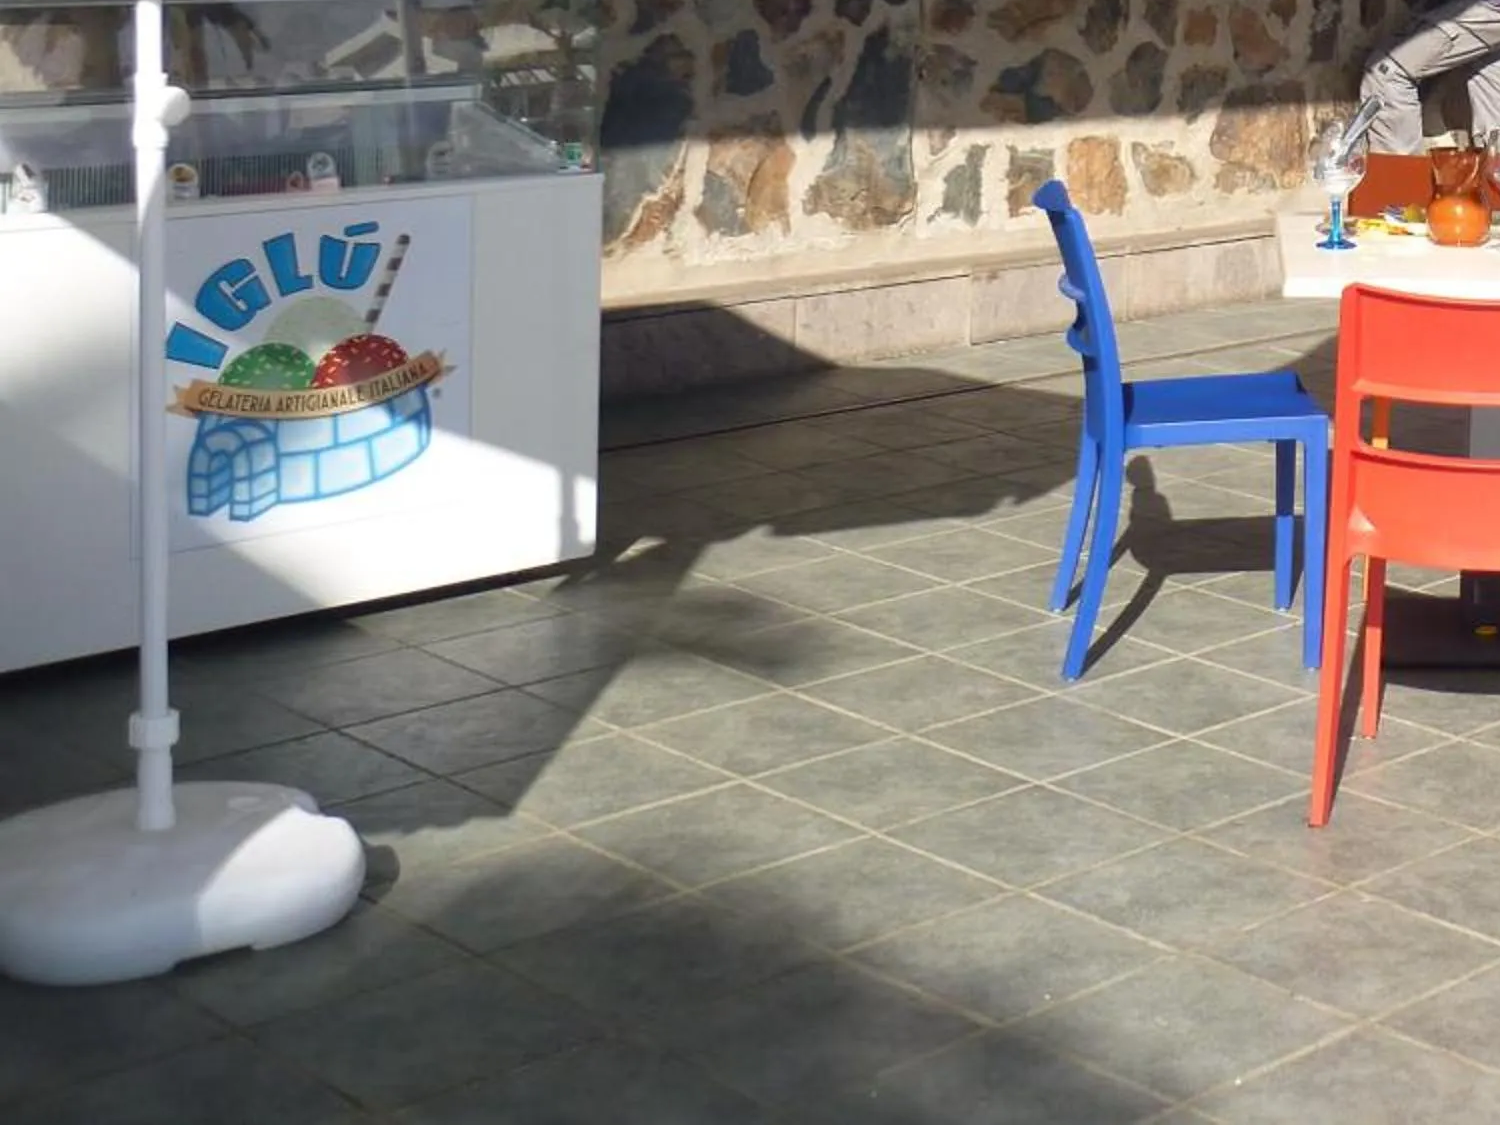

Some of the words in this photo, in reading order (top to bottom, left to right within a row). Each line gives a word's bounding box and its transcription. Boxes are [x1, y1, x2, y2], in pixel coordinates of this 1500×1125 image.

[198, 387, 271, 412] GELATERIA
[275, 385, 365, 412] ARTIGIANALE
[368, 362, 427, 400] ITALIANA
